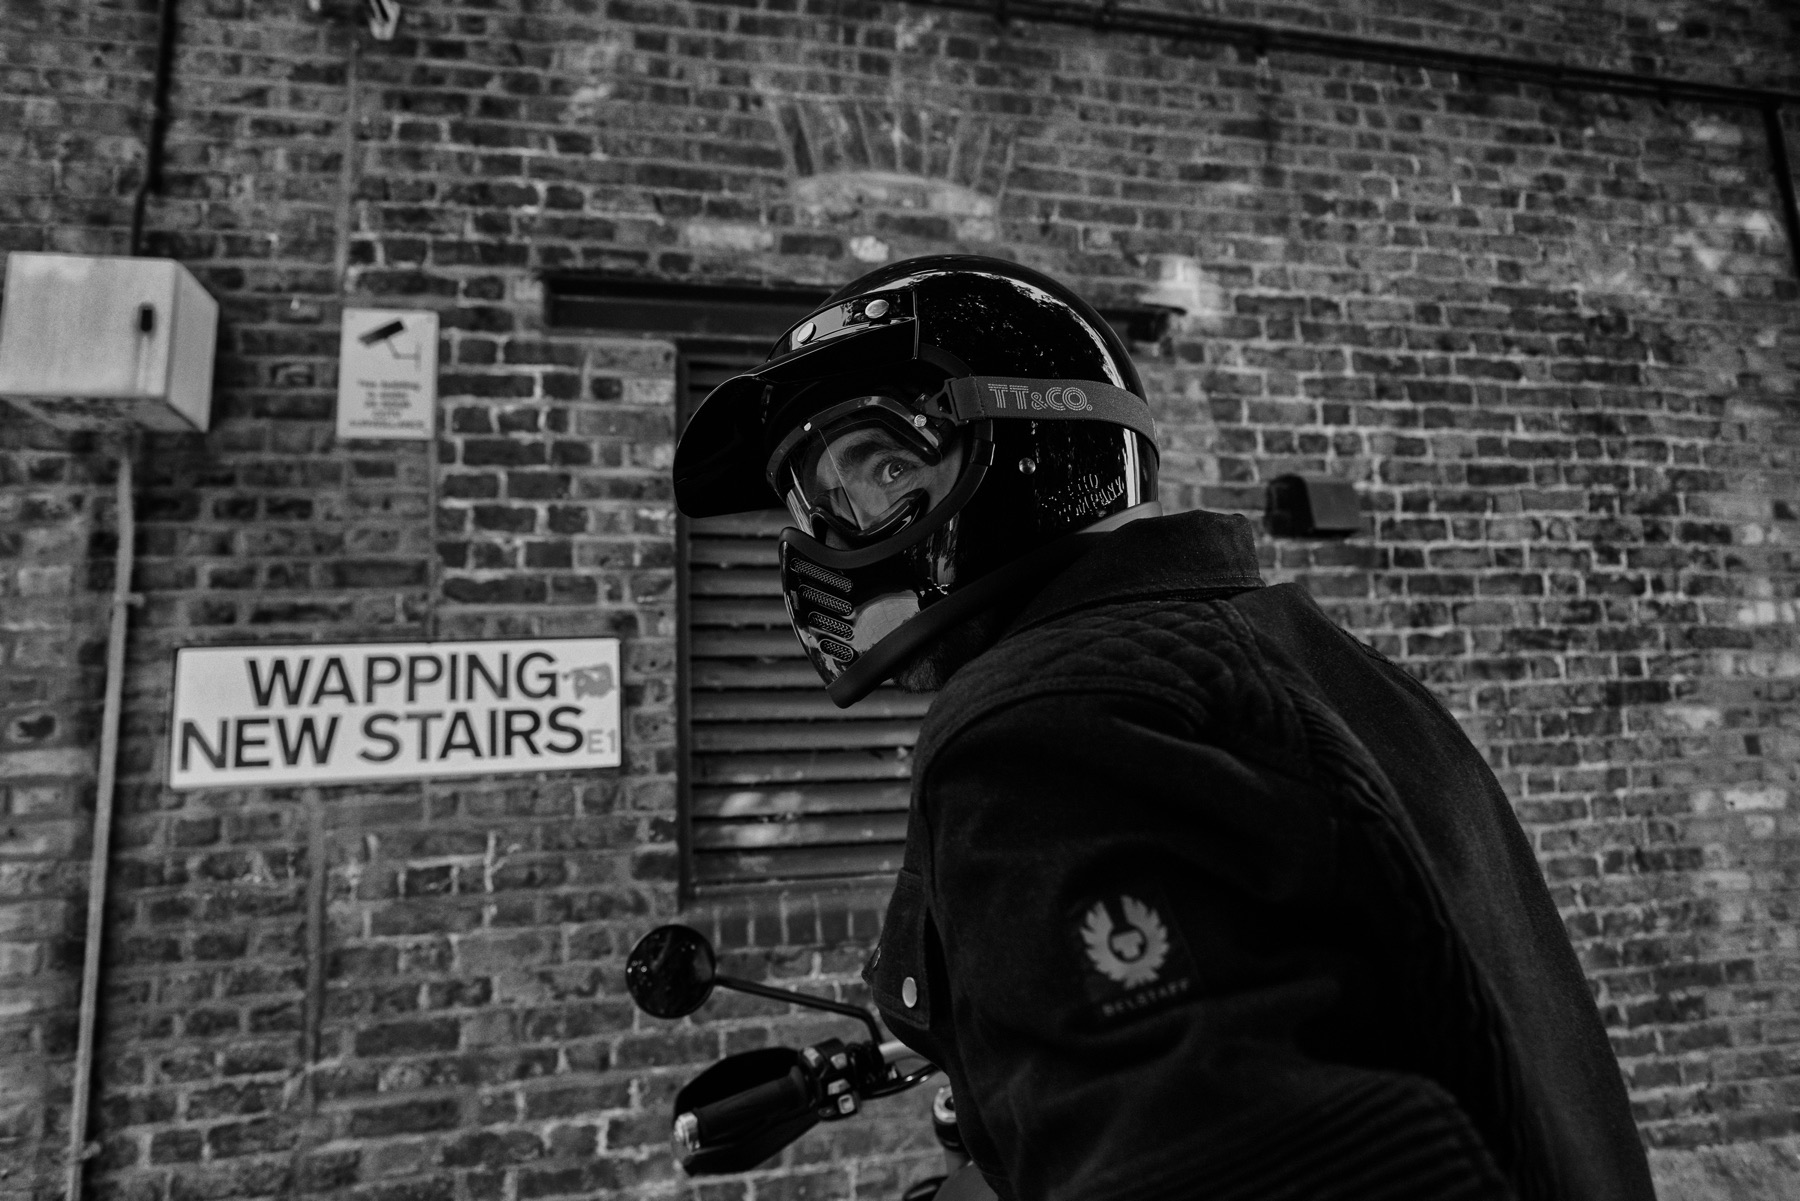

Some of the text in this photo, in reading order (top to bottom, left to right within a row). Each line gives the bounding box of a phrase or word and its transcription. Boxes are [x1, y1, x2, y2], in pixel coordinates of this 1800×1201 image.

[988, 383, 1093, 411] TT&CO.
[247, 651, 559, 709] WAPPING
[178, 705, 585, 772] NEW STAIRS
[587, 729, 616, 754] E1
